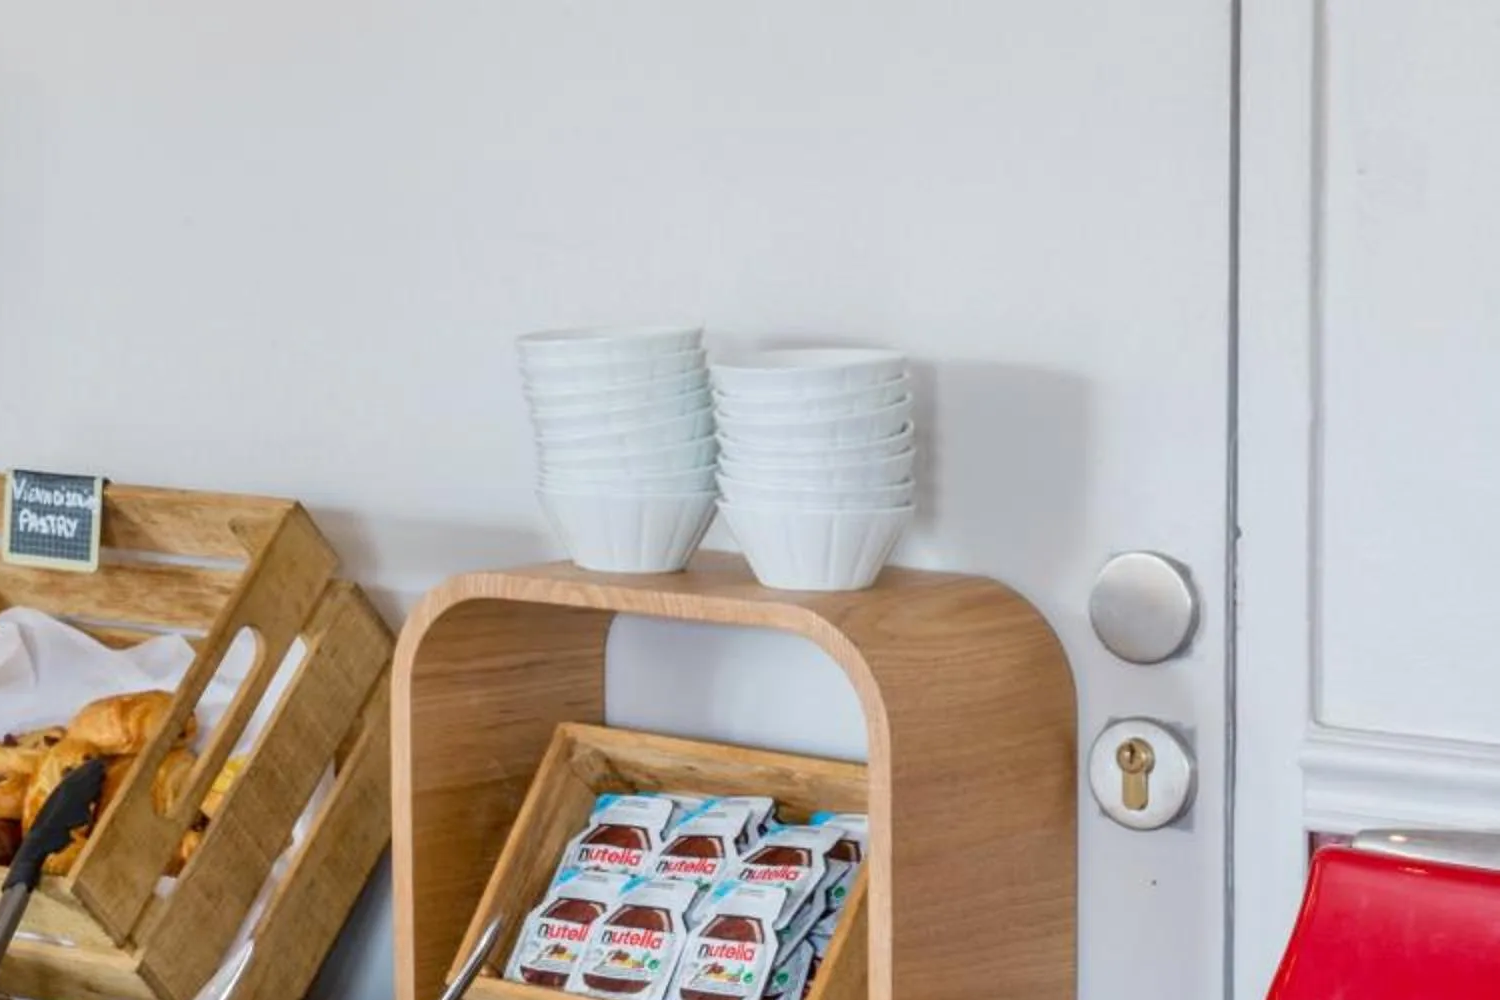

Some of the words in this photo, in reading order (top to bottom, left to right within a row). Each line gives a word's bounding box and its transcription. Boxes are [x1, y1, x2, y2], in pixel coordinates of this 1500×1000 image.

[19, 508, 79, 539] PASTRY
[578, 846, 643, 866] nutella
[656, 857, 717, 875] nutella
[739, 866, 800, 881] nutella
[537, 921, 590, 942] nutell
[601, 928, 664, 950] nutella
[698, 941, 756, 961] nutella
